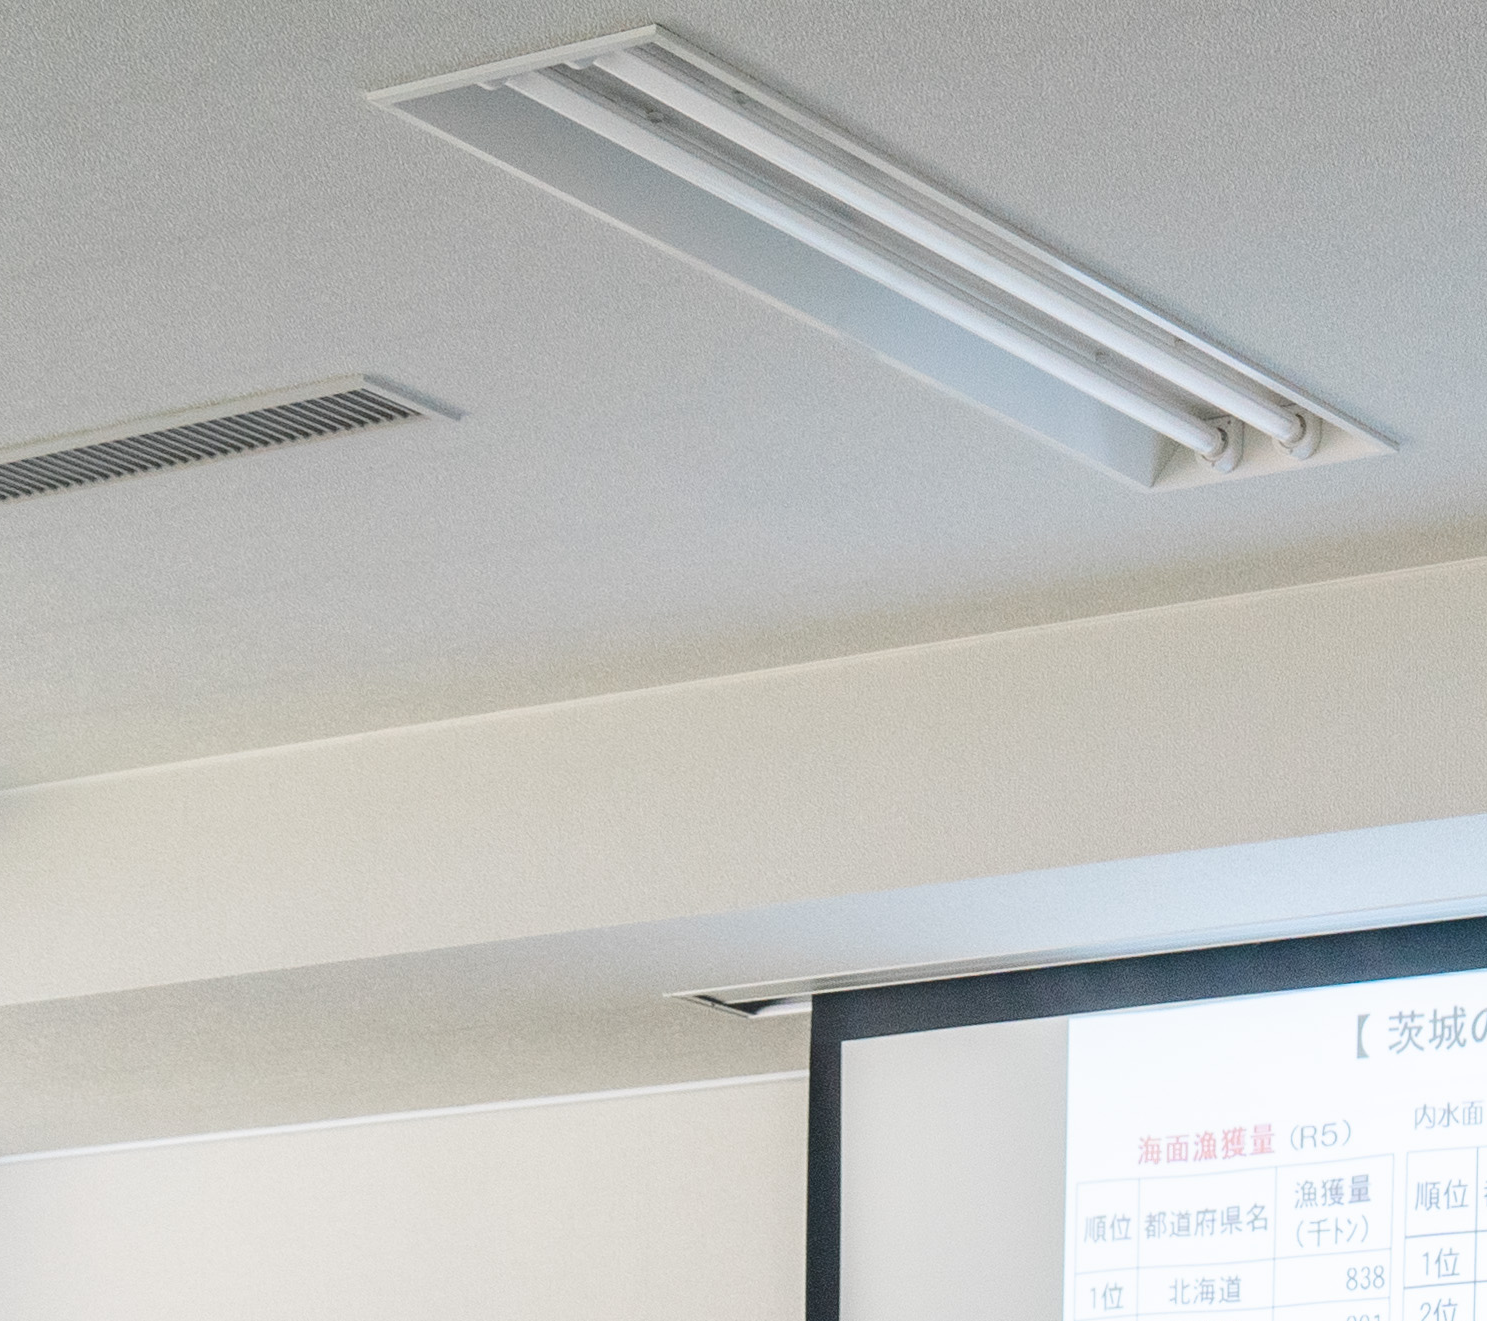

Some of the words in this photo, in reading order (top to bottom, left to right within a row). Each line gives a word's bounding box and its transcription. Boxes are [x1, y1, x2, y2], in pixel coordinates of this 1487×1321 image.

[1293, 1173, 1372, 1210] 漁獲量
[1413, 1178, 1470, 1212] 順位
[1083, 1213, 1132, 1244] 順位
[1143, 1202, 1269, 1240] 都道府県名
[1421, 1246, 1461, 1280] 1位
[1090, 1282, 1125, 1312] 1位
[1168, 1274, 1242, 1306] 北海道
[1345, 1264, 1386, 1293] 838
